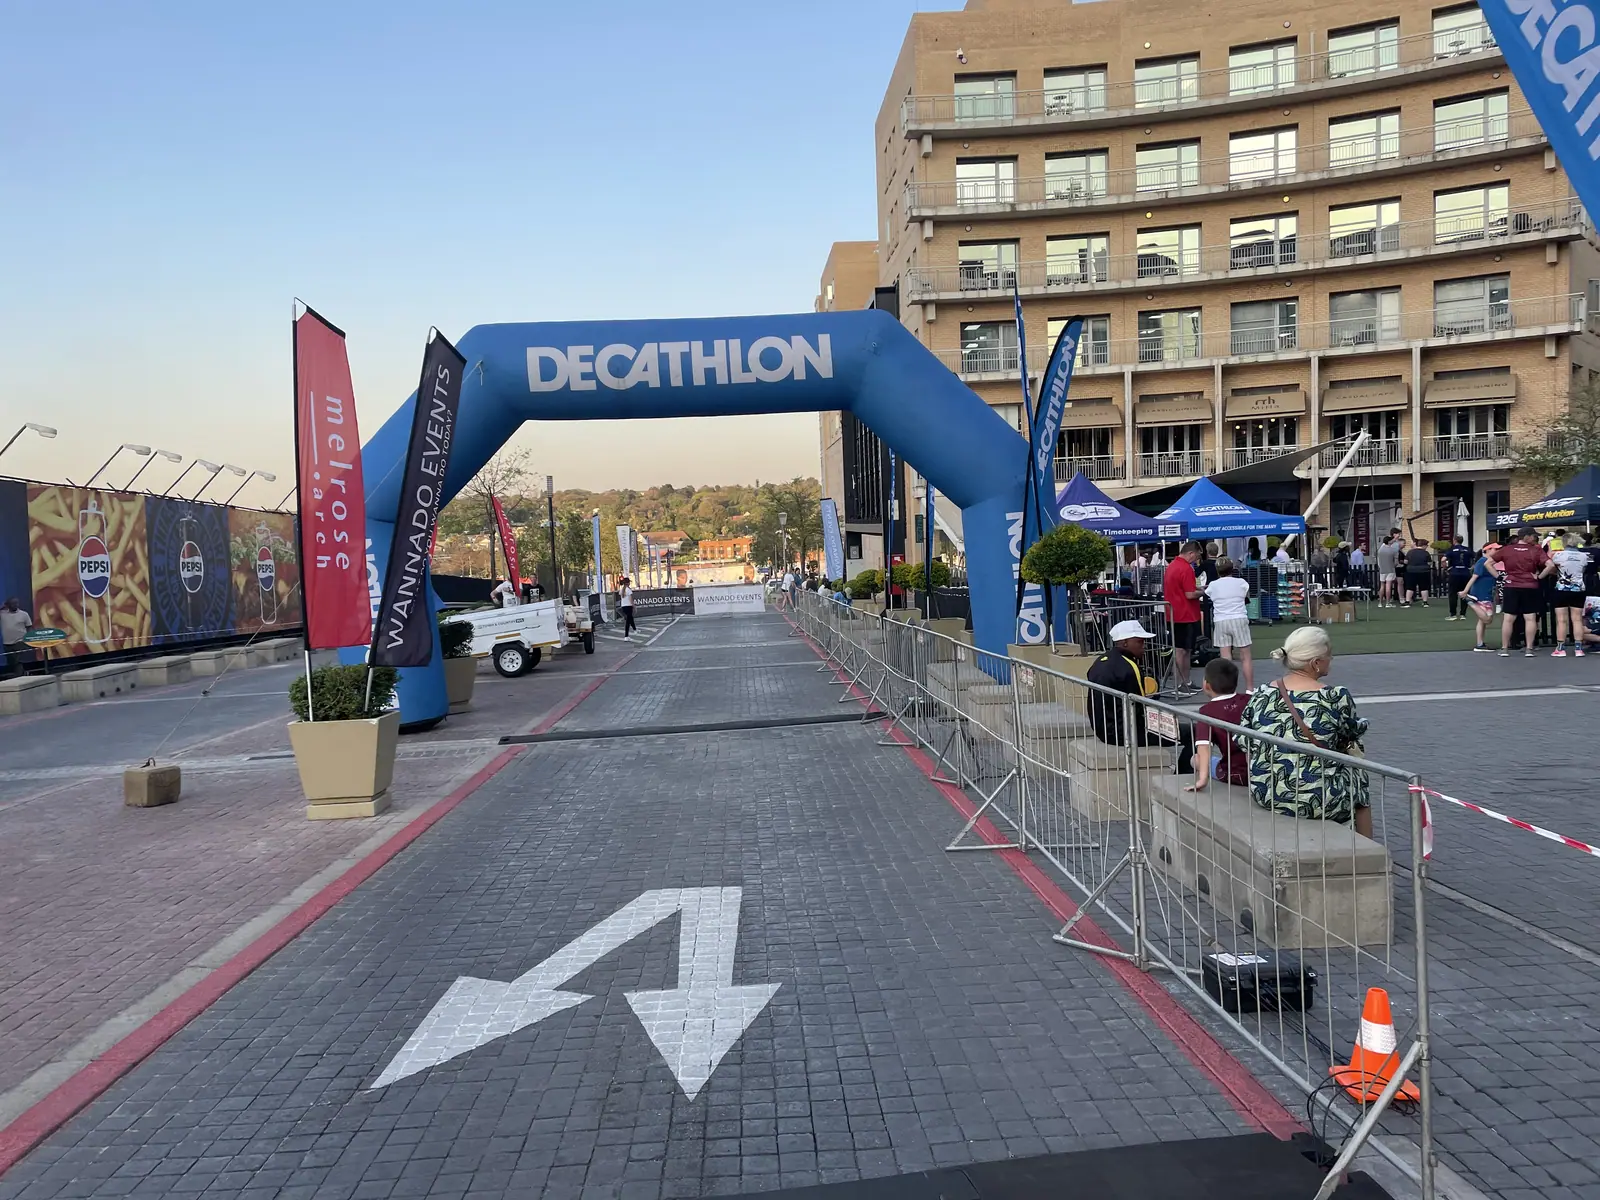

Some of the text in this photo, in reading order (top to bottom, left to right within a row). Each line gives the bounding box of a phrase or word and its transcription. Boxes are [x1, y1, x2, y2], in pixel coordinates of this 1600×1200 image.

[526, 334, 834, 392] DECATHLON
[442, 409, 453, 455] TODAY?
[439, 458, 447, 477] DO
[326, 395, 352, 570] melrose
[387, 364, 450, 649] WANNADO EVENTS
[1194, 505, 1244, 513] DECATHLON
[1522, 512, 1544, 522] Sports
[1544, 509, 1575, 519] Nutrition
[1103, 528, 1153, 536] Timekeeping
[80, 560, 109, 573] PEPSI
[181, 561, 203, 572] PEPSI
[258, 563, 274, 573] PEPSI
[664, 596, 691, 604] EVENTS
[697, 594, 736, 604] WANNADO
[736, 593, 762, 601] EVENTS
